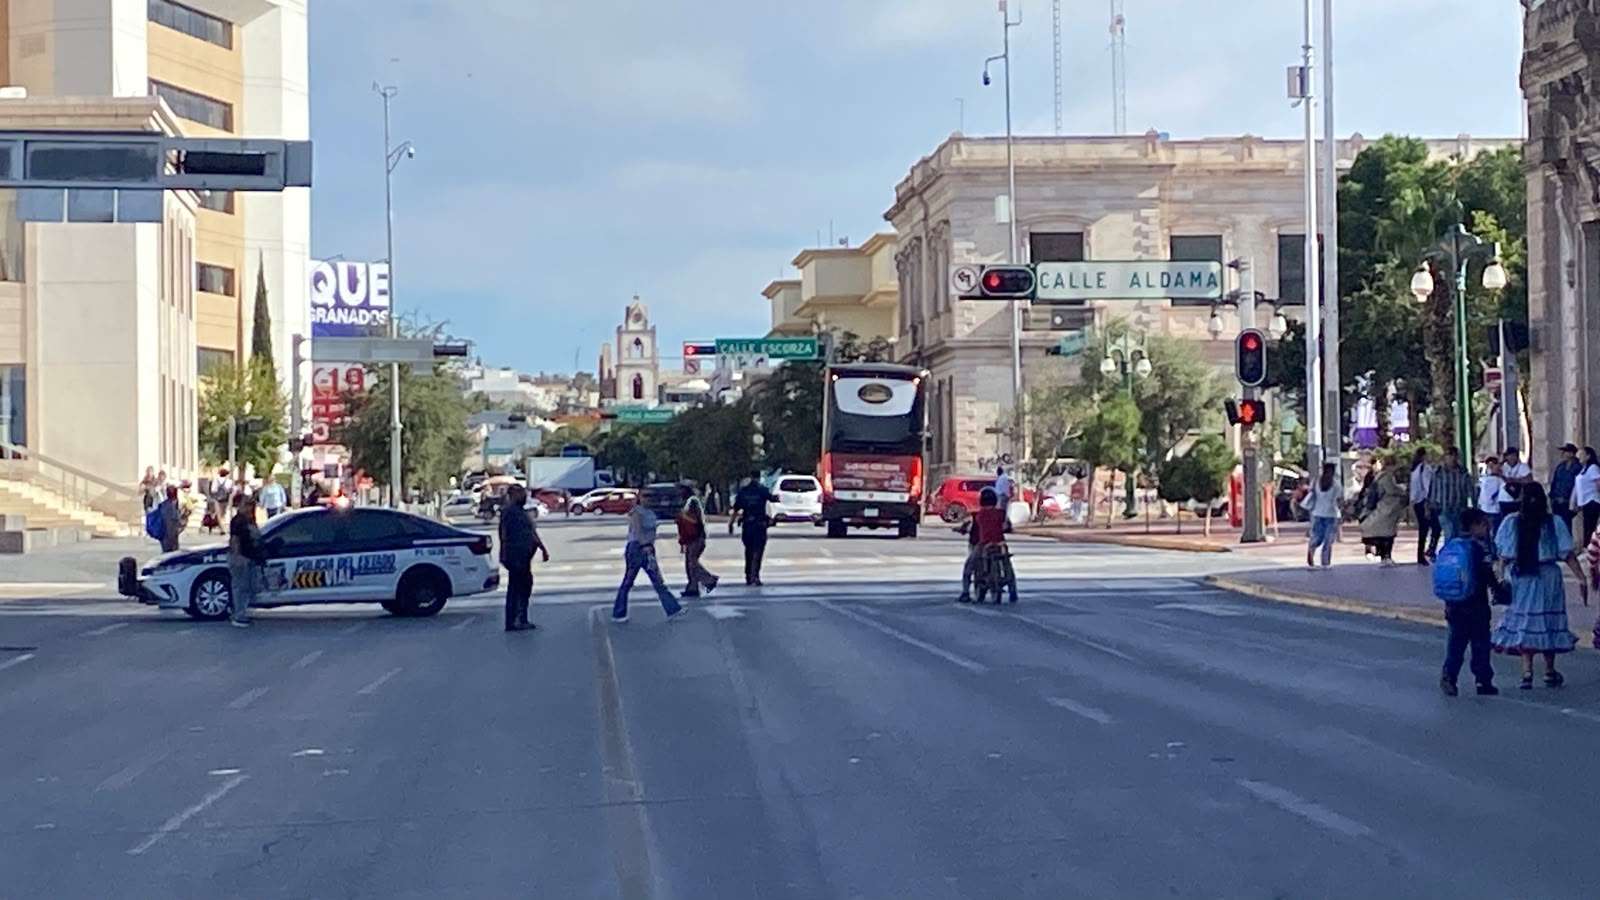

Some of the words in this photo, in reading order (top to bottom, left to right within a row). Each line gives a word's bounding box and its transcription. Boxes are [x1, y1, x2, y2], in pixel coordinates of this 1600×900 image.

[311, 261, 389, 308] QUE
[1039, 271, 1107, 289] CALLE
[1129, 271, 1219, 289] ALDAMA
[720, 343, 756, 354] CALLE
[761, 343, 812, 353] ESCORZA
[358, 553, 396, 568] ESTADO
[324, 568, 355, 586] VIAL
